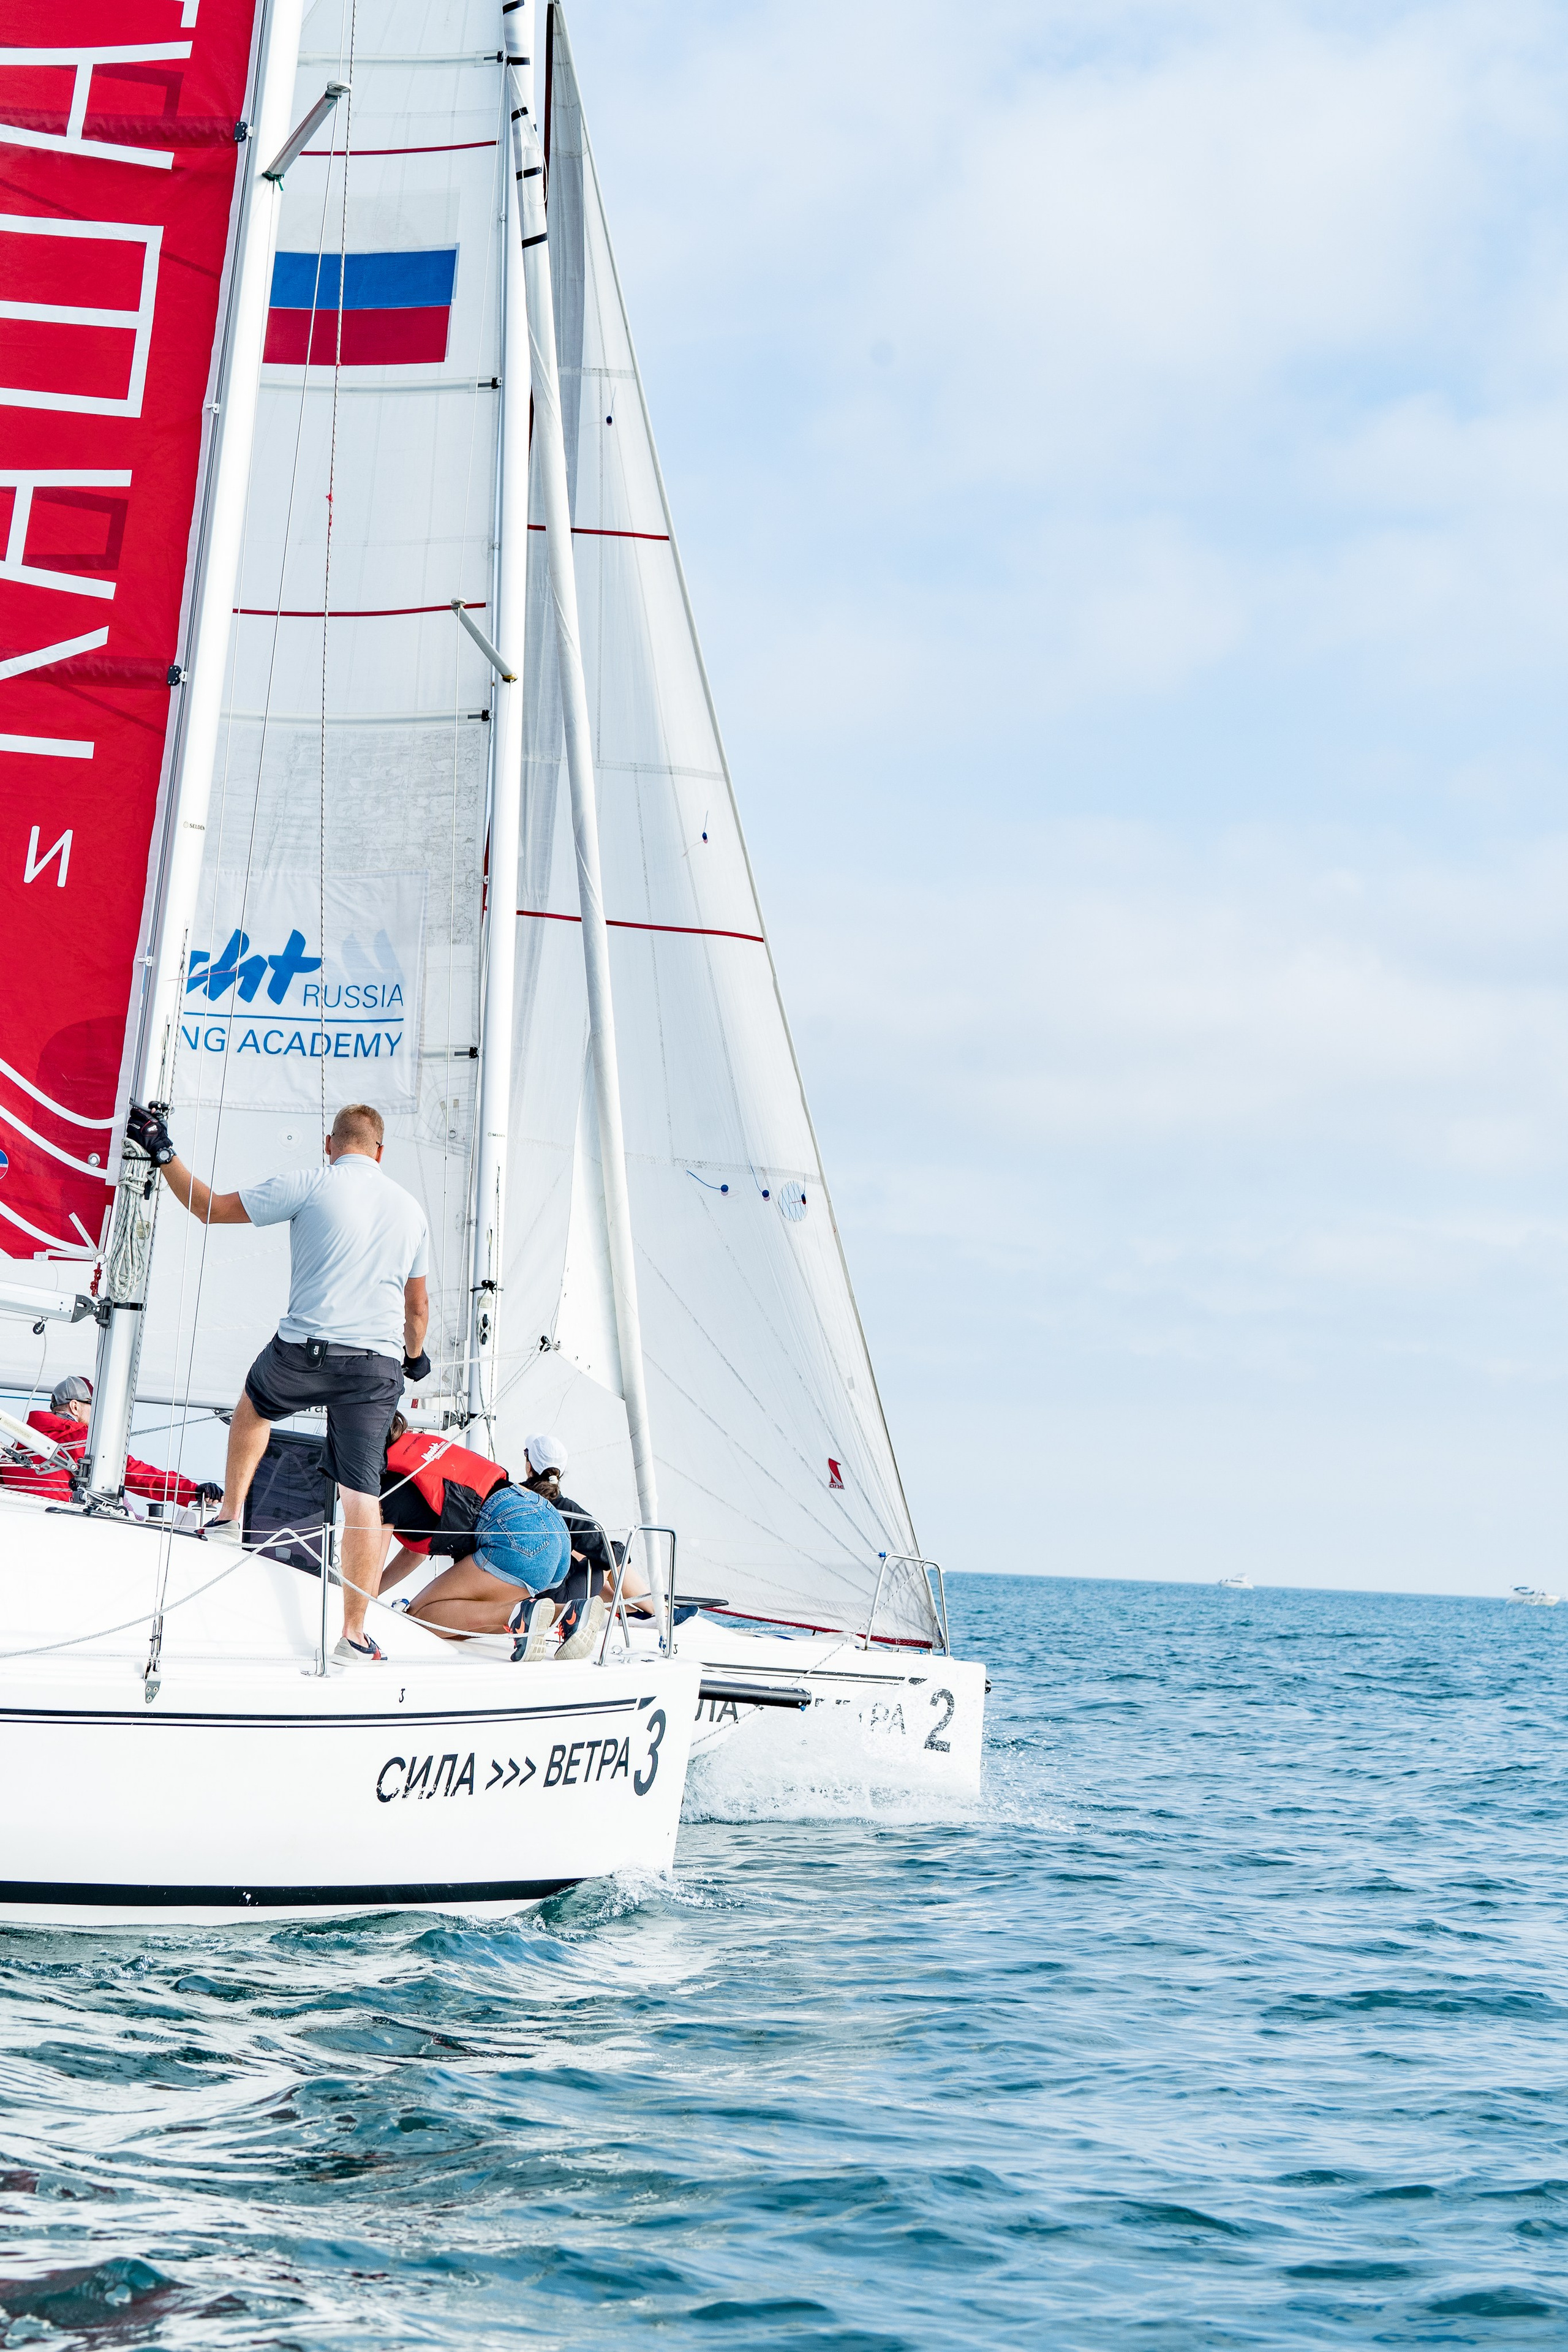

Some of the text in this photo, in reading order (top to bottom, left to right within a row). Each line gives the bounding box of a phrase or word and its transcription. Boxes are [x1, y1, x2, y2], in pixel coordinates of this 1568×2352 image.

[303, 984, 404, 1008] RUSSIA
[236, 1029, 403, 1058] ACADEMY
[923, 1688, 955, 1753] 2
[375, 1708, 666, 1803] СИЛА ВЕТРА 3
